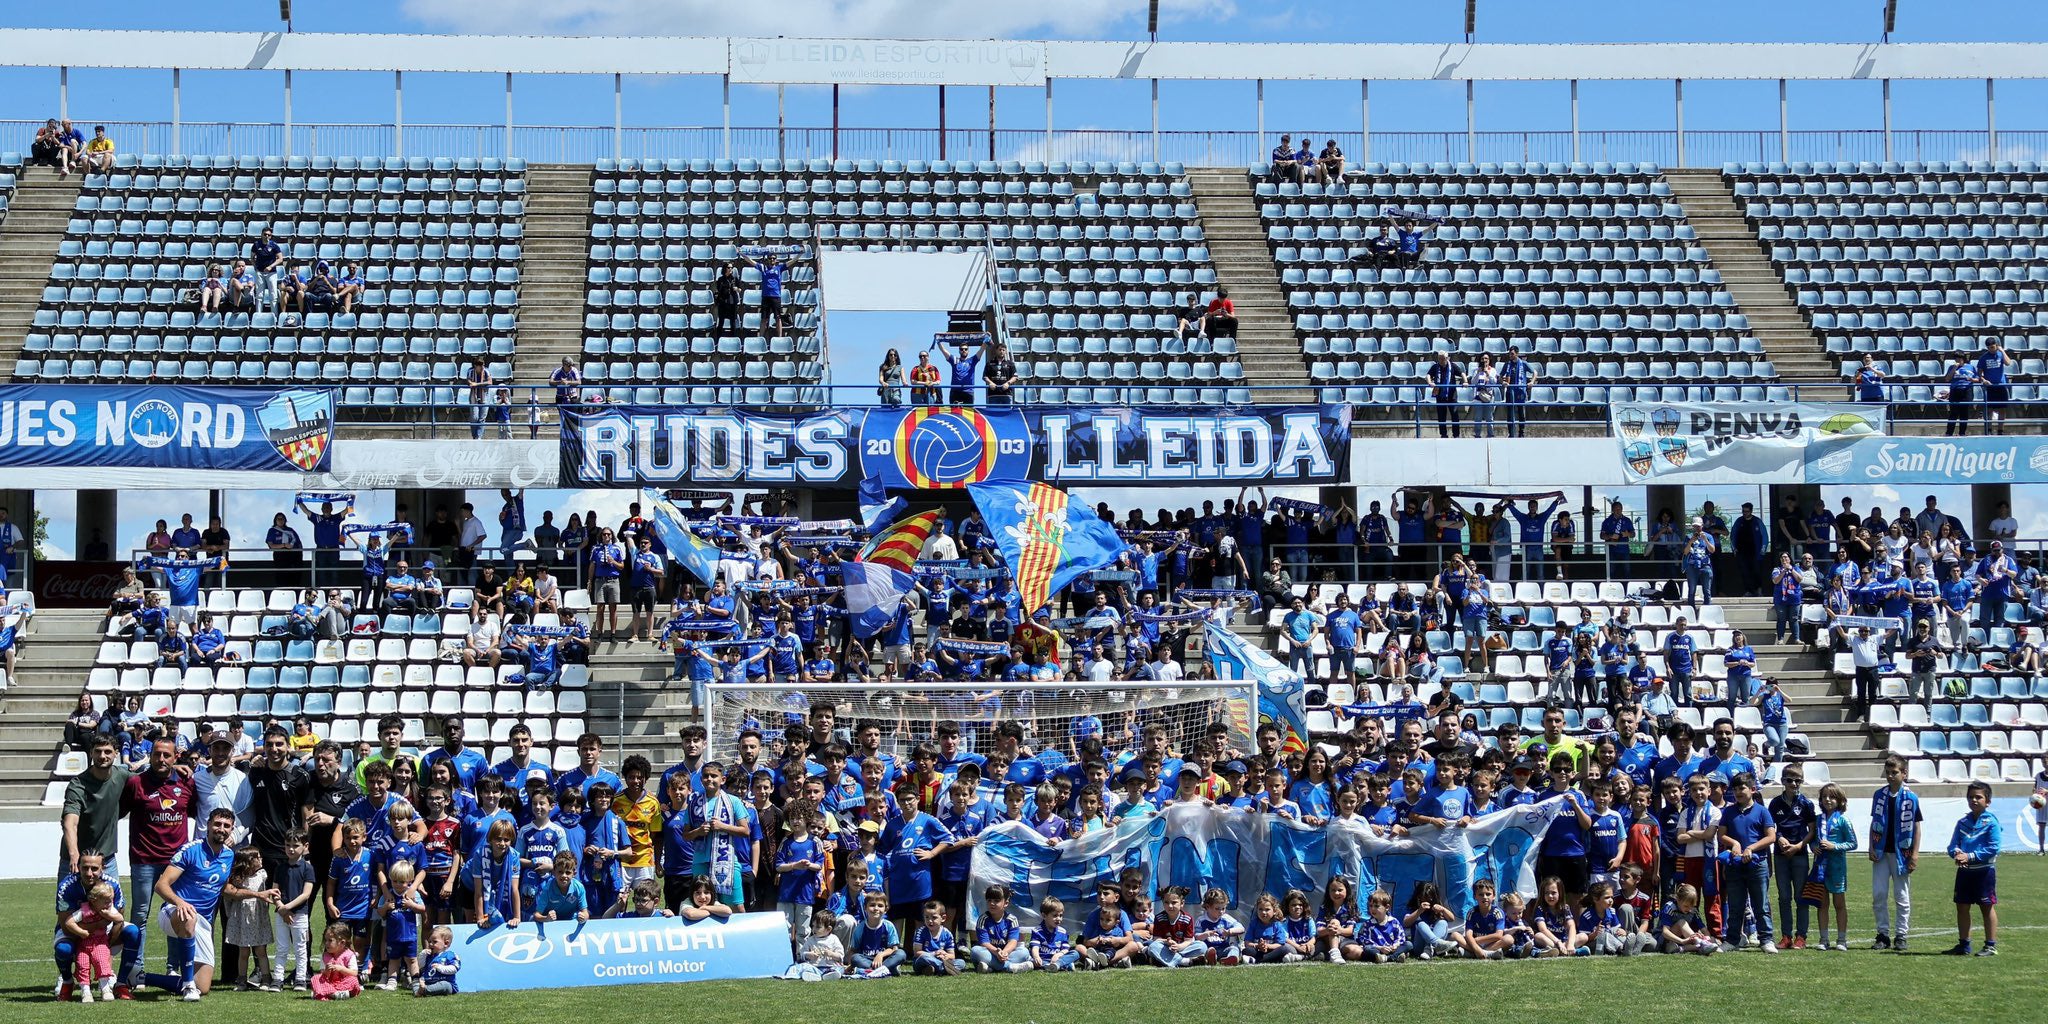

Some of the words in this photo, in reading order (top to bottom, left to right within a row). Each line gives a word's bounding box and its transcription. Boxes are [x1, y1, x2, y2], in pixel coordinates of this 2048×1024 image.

[775, 44, 866, 63] LLEIDA
[874, 44, 1000, 64] ESPORTIU
[831, 68, 945, 80] www.lleidaesportiu.cat
[299, 427, 327, 440] ESPORTIU
[1691, 413, 1802, 437] PENYA
[578, 414, 848, 482] RUDES
[866, 439, 891, 455] 20
[999, 439, 1024, 455] 03
[1042, 412, 1336, 480] LLEIDA
[453, 473, 493, 486] HOTELS
[563, 926, 725, 957] HYUNDAI
[593, 961, 654, 978] Control
[658, 959, 707, 975] Motor
